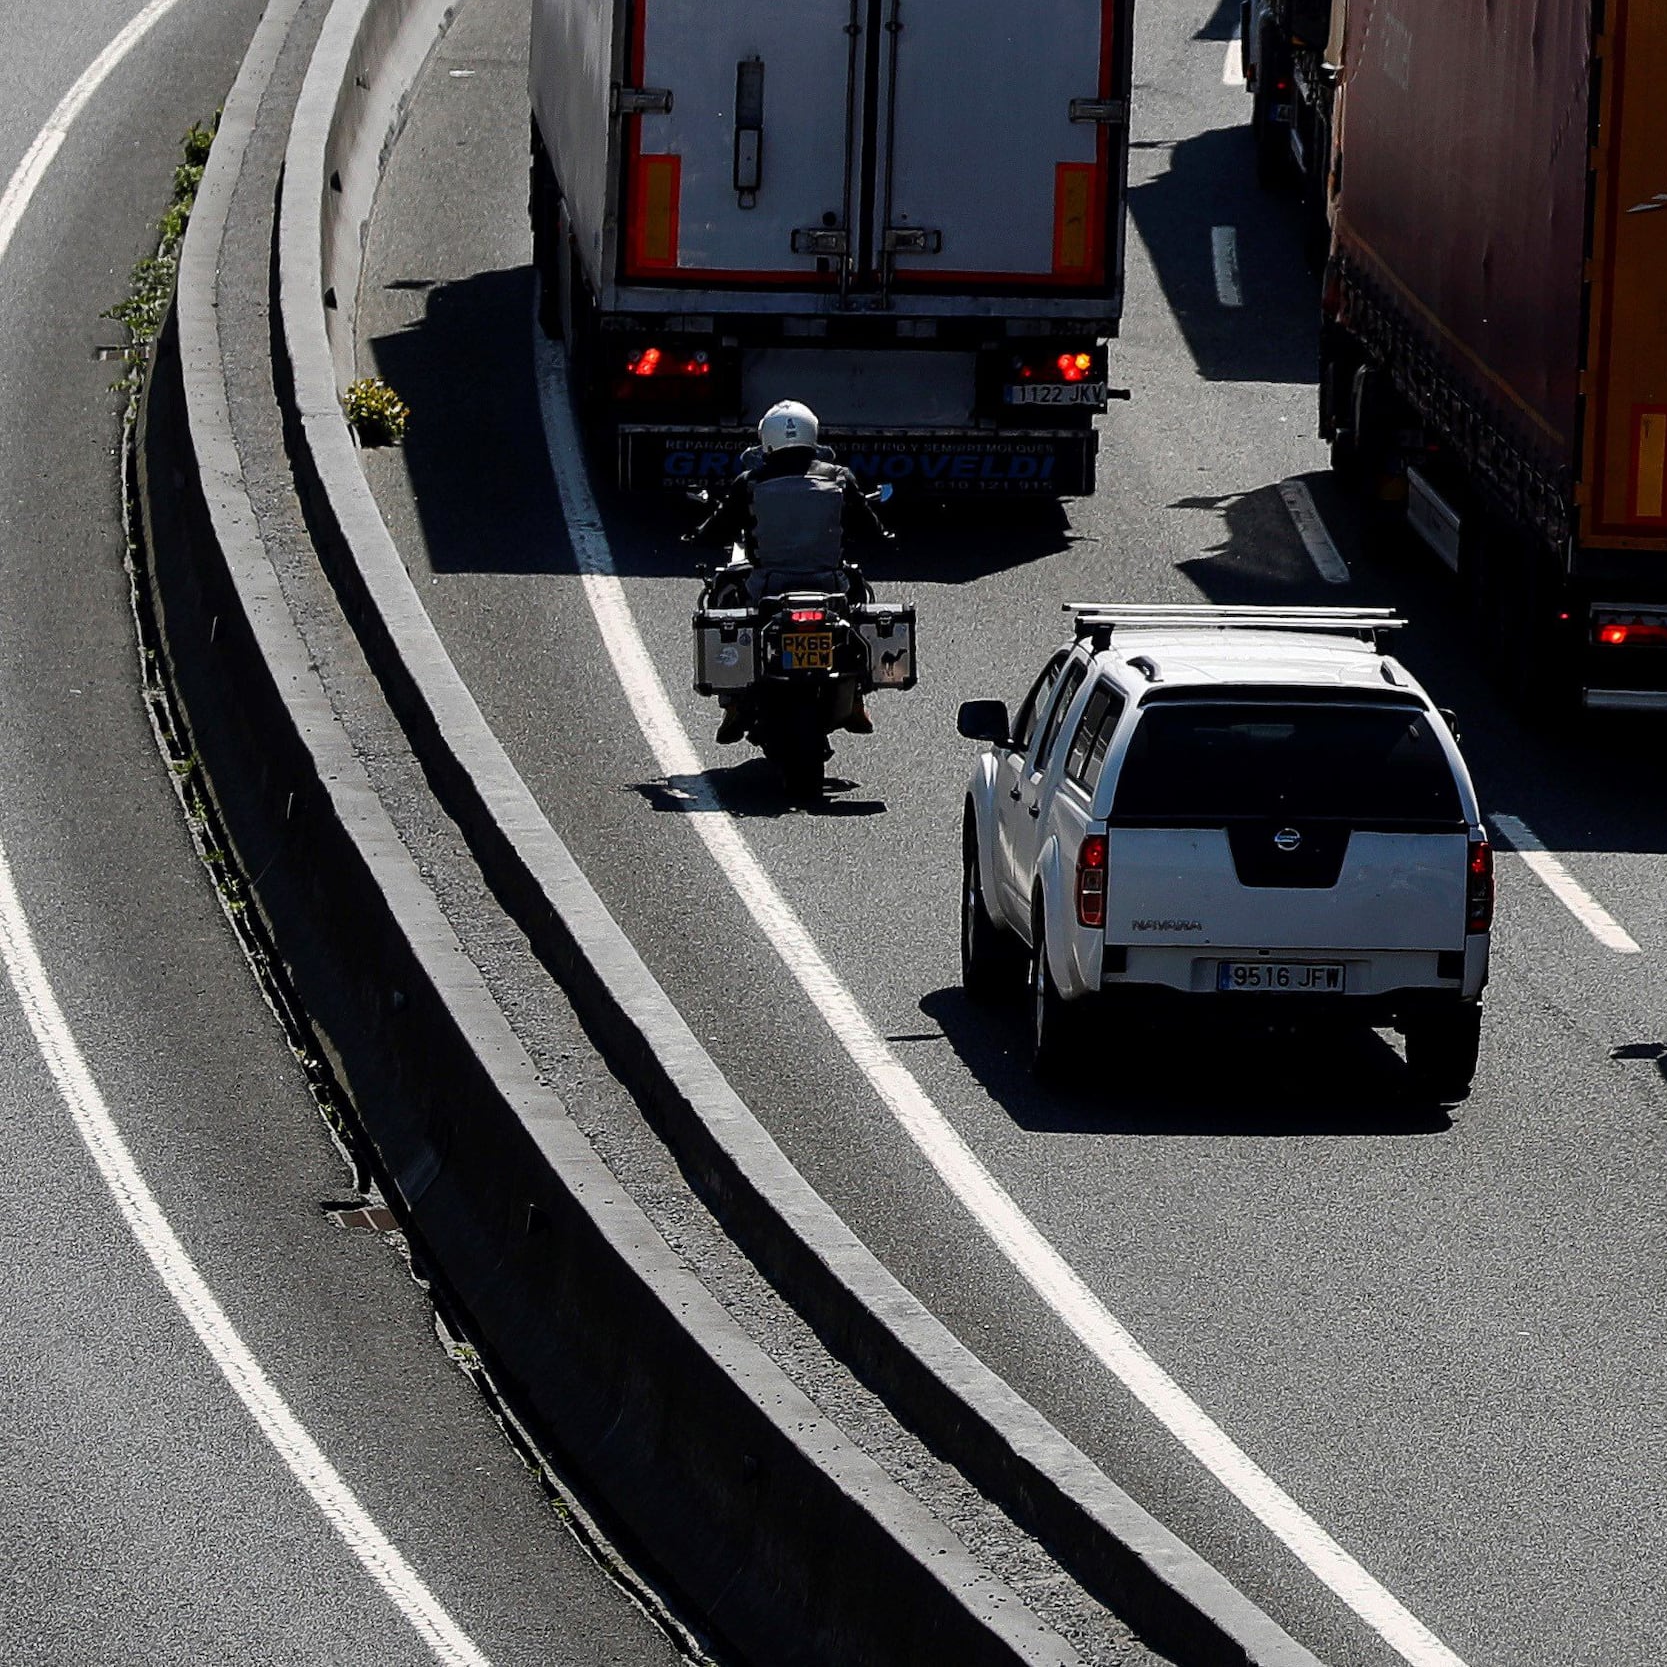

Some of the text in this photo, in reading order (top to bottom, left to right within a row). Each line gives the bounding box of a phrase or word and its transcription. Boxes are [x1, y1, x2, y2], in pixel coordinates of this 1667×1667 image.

[1018, 386, 1101, 404] 1122 JKV
[664, 438, 754, 453] REPARACIO
[849, 453, 1057, 478] NOVELDI
[783, 636, 830, 651] PK66
[794, 652, 830, 666] YCW
[1132, 920, 1202, 932] NAVARA
[1233, 966, 1340, 988] 9516 JFW
